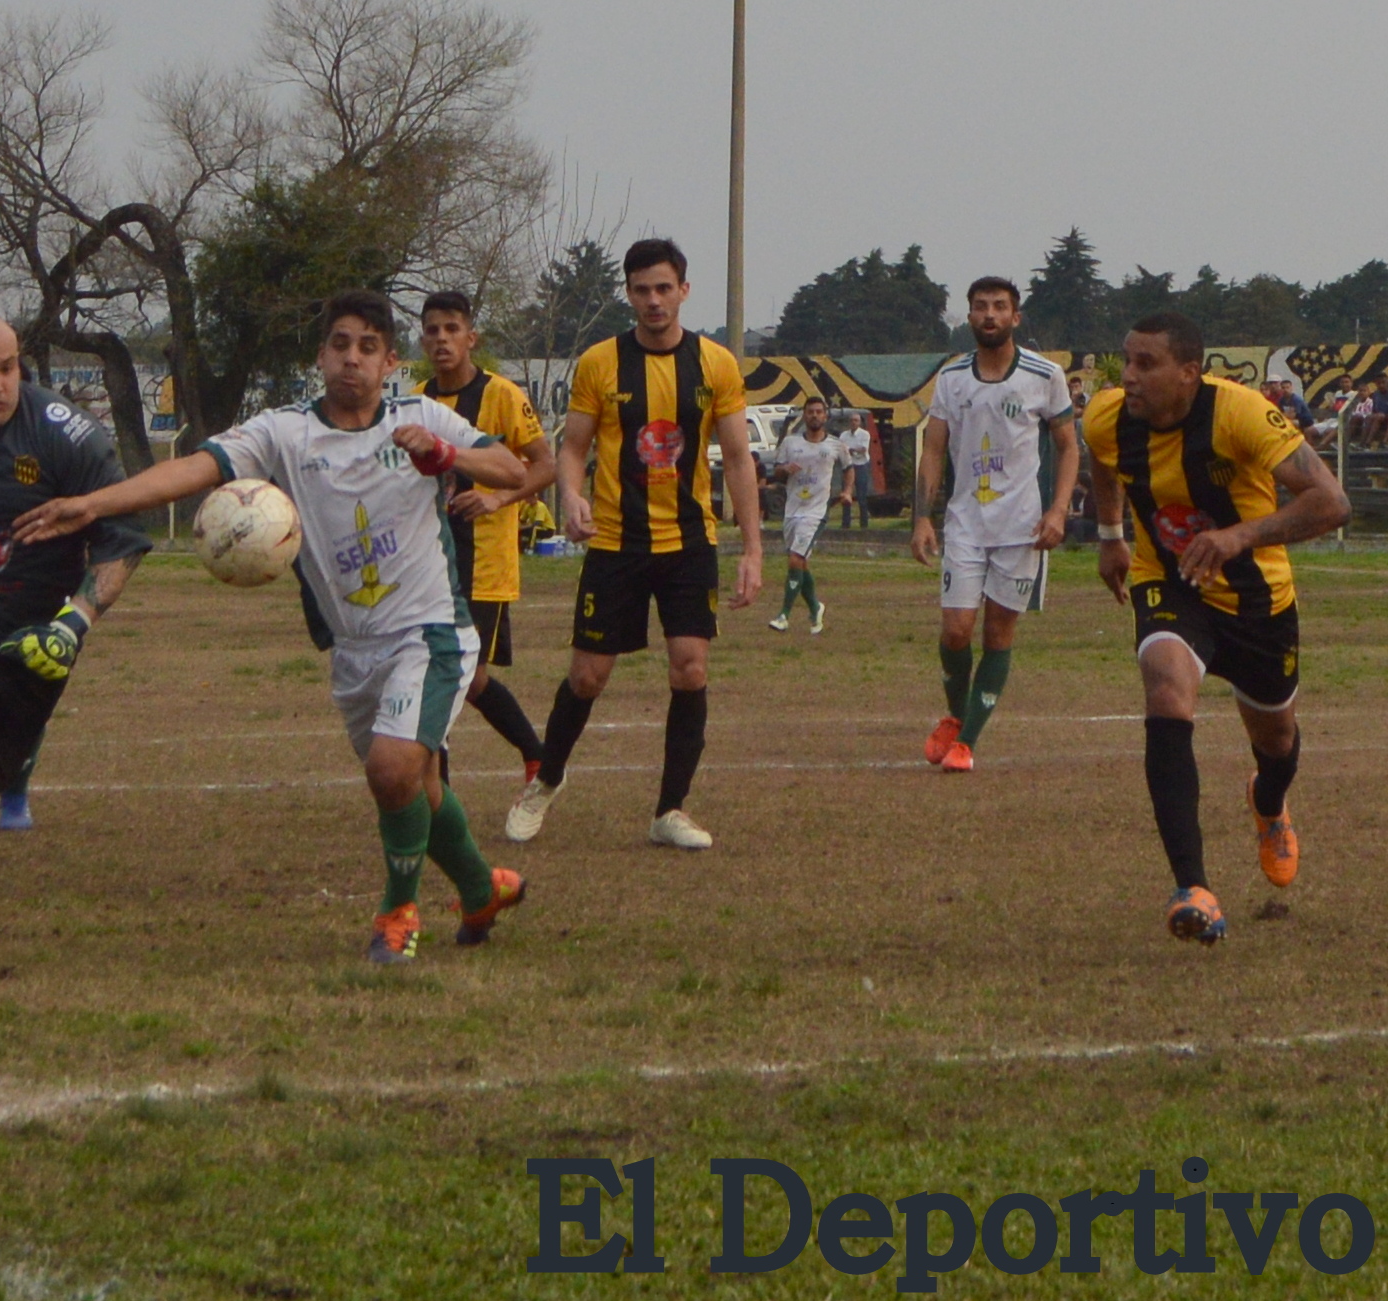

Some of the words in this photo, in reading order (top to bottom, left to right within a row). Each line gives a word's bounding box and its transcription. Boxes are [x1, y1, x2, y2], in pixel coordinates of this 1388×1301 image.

[943, 570, 952, 593] 9
[583, 592, 595, 618] 5
[1146, 587, 1162, 608] 6
